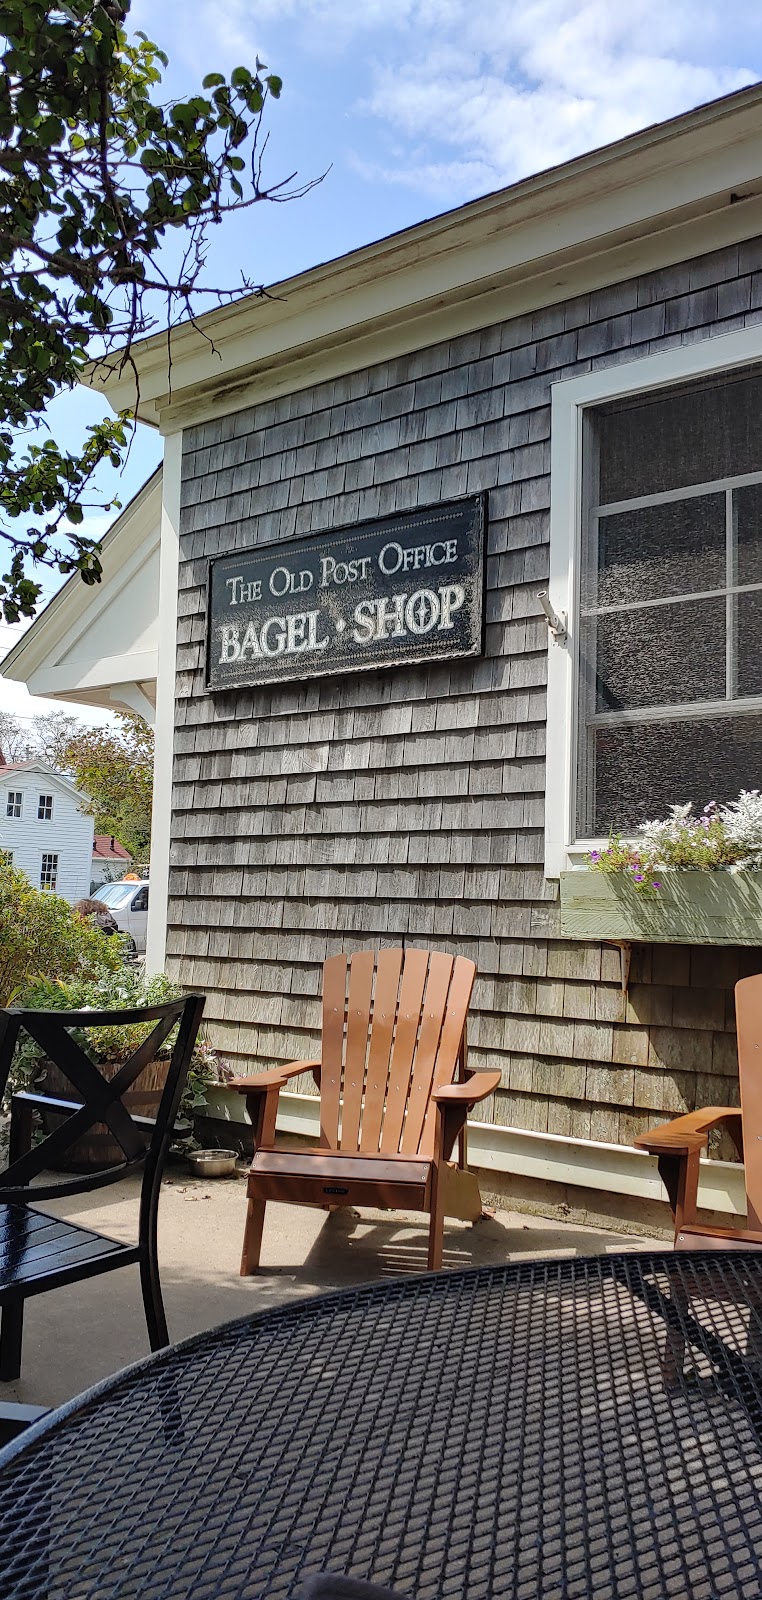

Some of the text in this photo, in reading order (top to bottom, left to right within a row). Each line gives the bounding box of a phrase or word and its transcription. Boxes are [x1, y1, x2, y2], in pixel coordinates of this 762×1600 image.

[225, 539, 458, 606] THE OLD POST OFFICE
[218, 584, 466, 665] BAGEL SHOP
